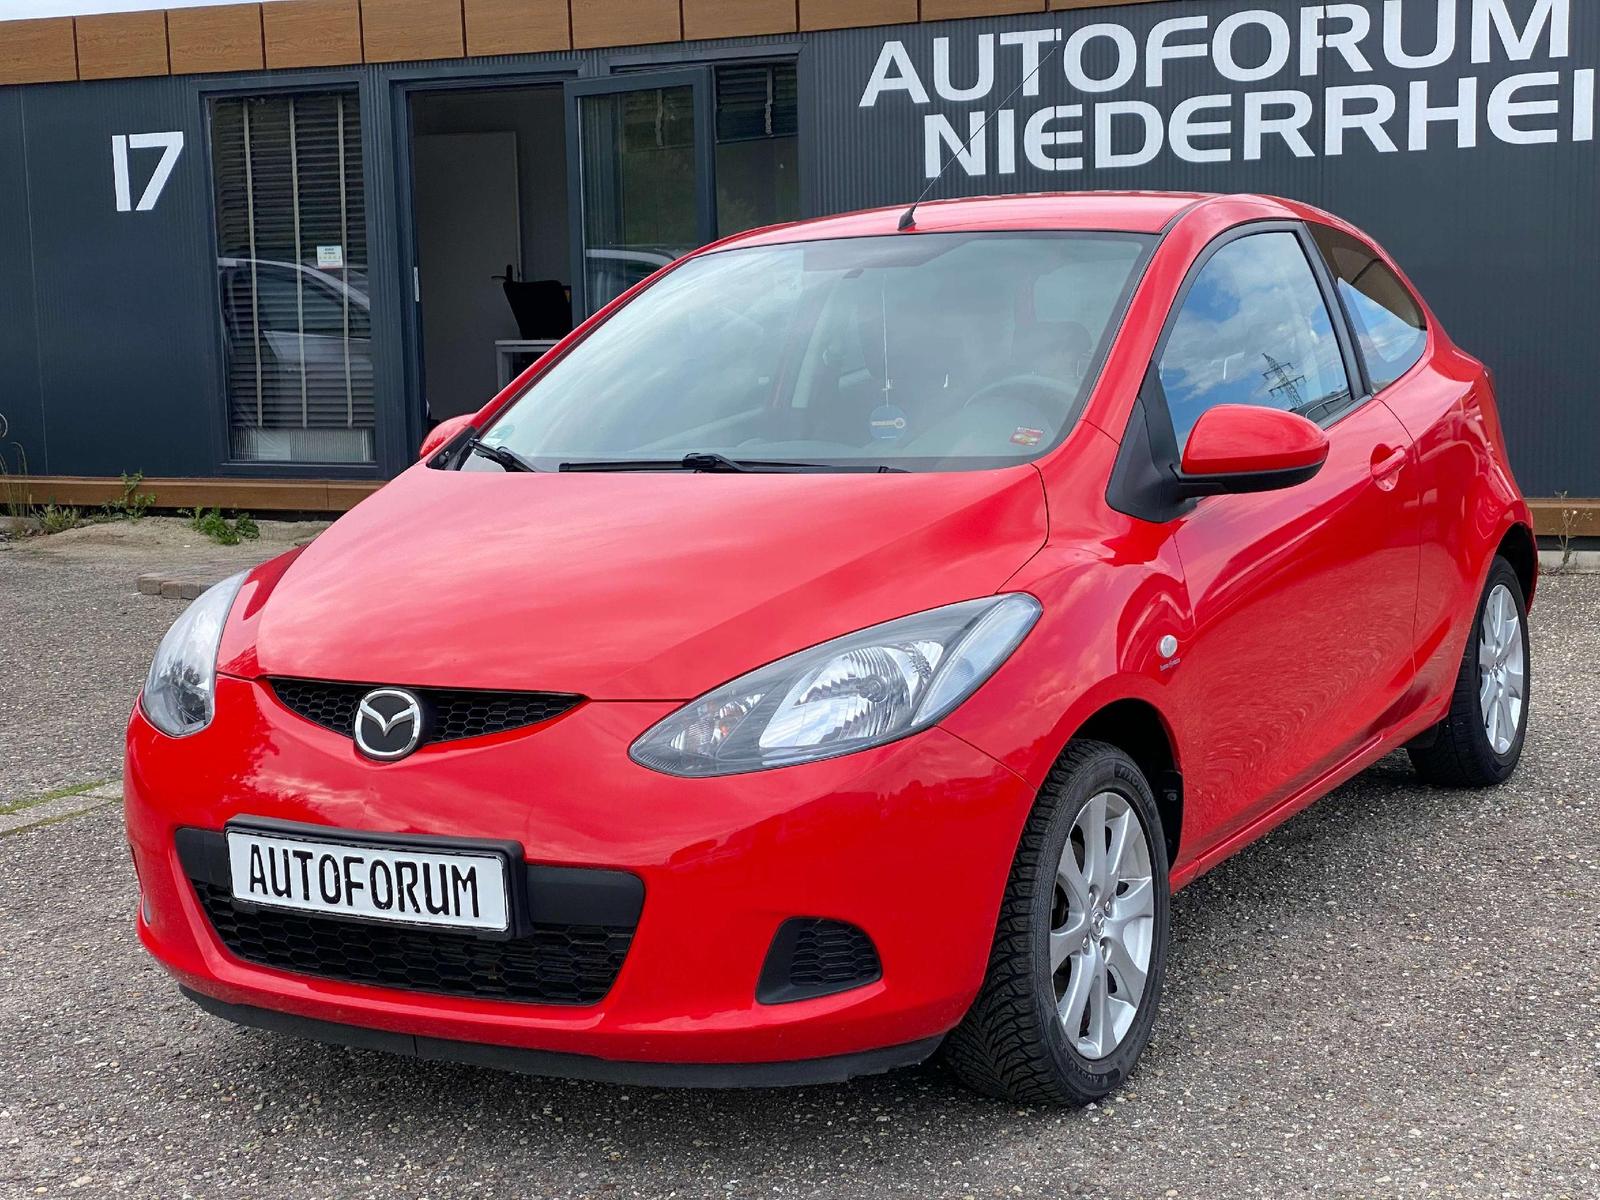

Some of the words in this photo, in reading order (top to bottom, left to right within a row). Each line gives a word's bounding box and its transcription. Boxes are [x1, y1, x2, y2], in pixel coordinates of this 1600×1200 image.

[859, 0, 1570, 107] AUTOFORUM
[111, 131, 184, 212] 17
[249, 843, 480, 918] AUTOFORUM
